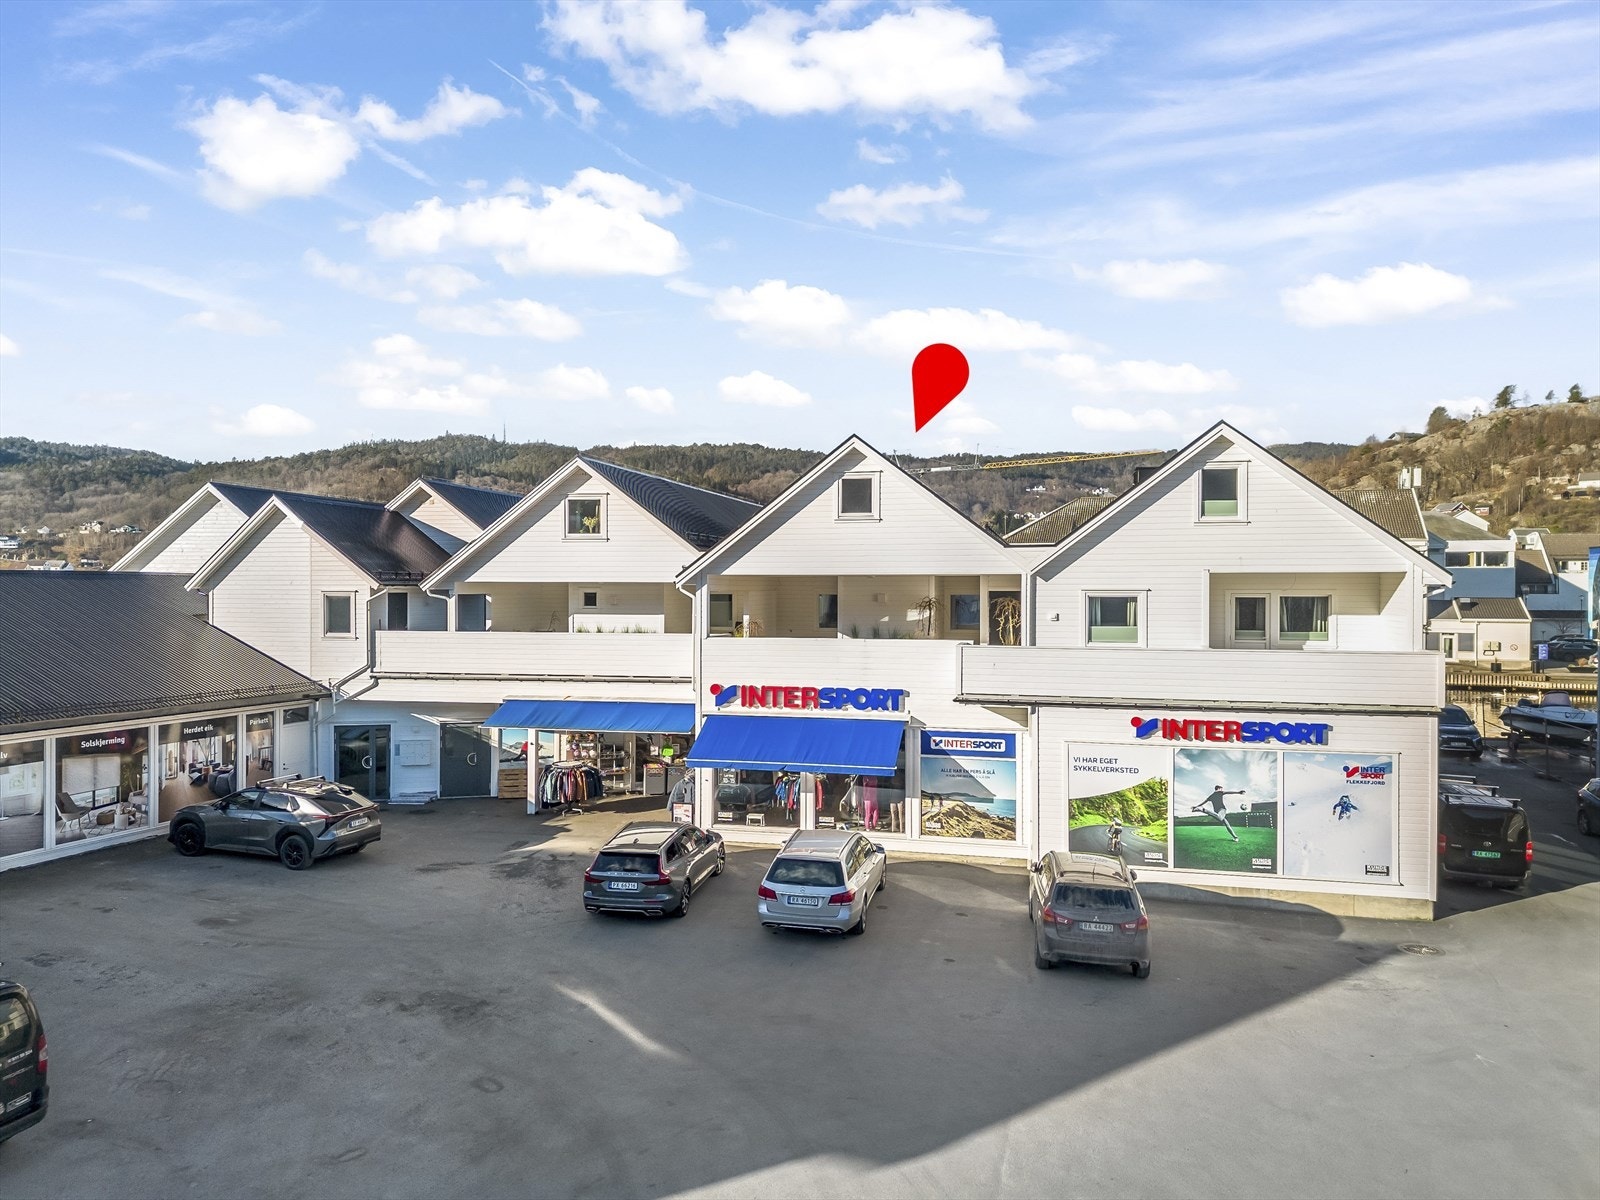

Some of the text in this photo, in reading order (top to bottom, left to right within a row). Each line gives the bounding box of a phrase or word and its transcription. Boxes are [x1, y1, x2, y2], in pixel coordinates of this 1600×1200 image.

[741, 684, 905, 712] INTERSPORT
[249, 717, 269, 726] Parkett
[183, 724, 214, 735] Herdet eik
[1162, 718, 1328, 744] INTERSPORT
[81, 736, 126, 748] Solskjerming
[944, 739, 1003, 750] INTERSPORT
[1073, 765, 1140, 774] SYKKELVERKSTED
